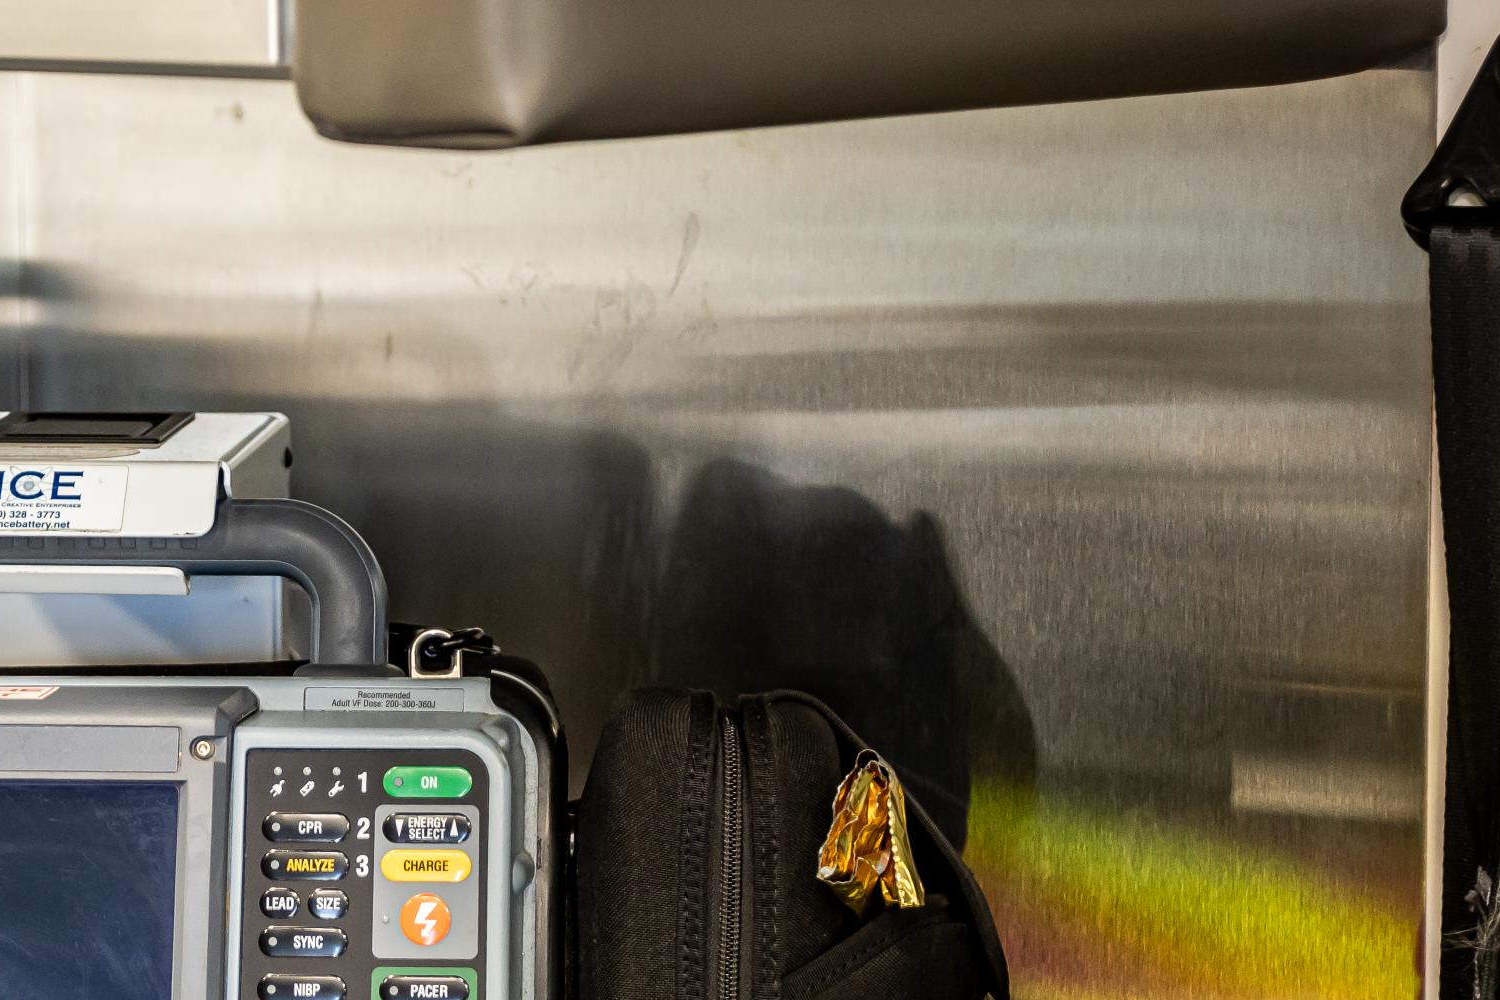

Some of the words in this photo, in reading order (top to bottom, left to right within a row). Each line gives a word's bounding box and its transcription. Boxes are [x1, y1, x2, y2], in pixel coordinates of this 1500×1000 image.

[9, 510, 28, 519] 328
[36, 510, 61, 519] 3773
[357, 690, 411, 700] Recommended
[331, 698, 351, 708] Adult
[352, 699, 362, 708] VF
[363, 699, 384, 708] Dose:
[385, 699, 436, 709] 200-300-360J
[356, 771, 369, 794] 1
[420, 775, 438, 789] ON
[297, 819, 323, 835] CPR
[356, 816, 371, 840] 2
[407, 816, 448, 829] ENERGY
[408, 828, 446, 840] SELECT
[286, 857, 336, 873] ANALYZE
[355, 854, 369, 878] 3
[402, 859, 450, 872] CHARGE
[265, 897, 295, 911] LEAD
[315, 897, 341, 910] SIZE
[293, 935, 324, 949] SYNC
[293, 983, 321, 997] NIBP
[409, 984, 449, 998] PACER
